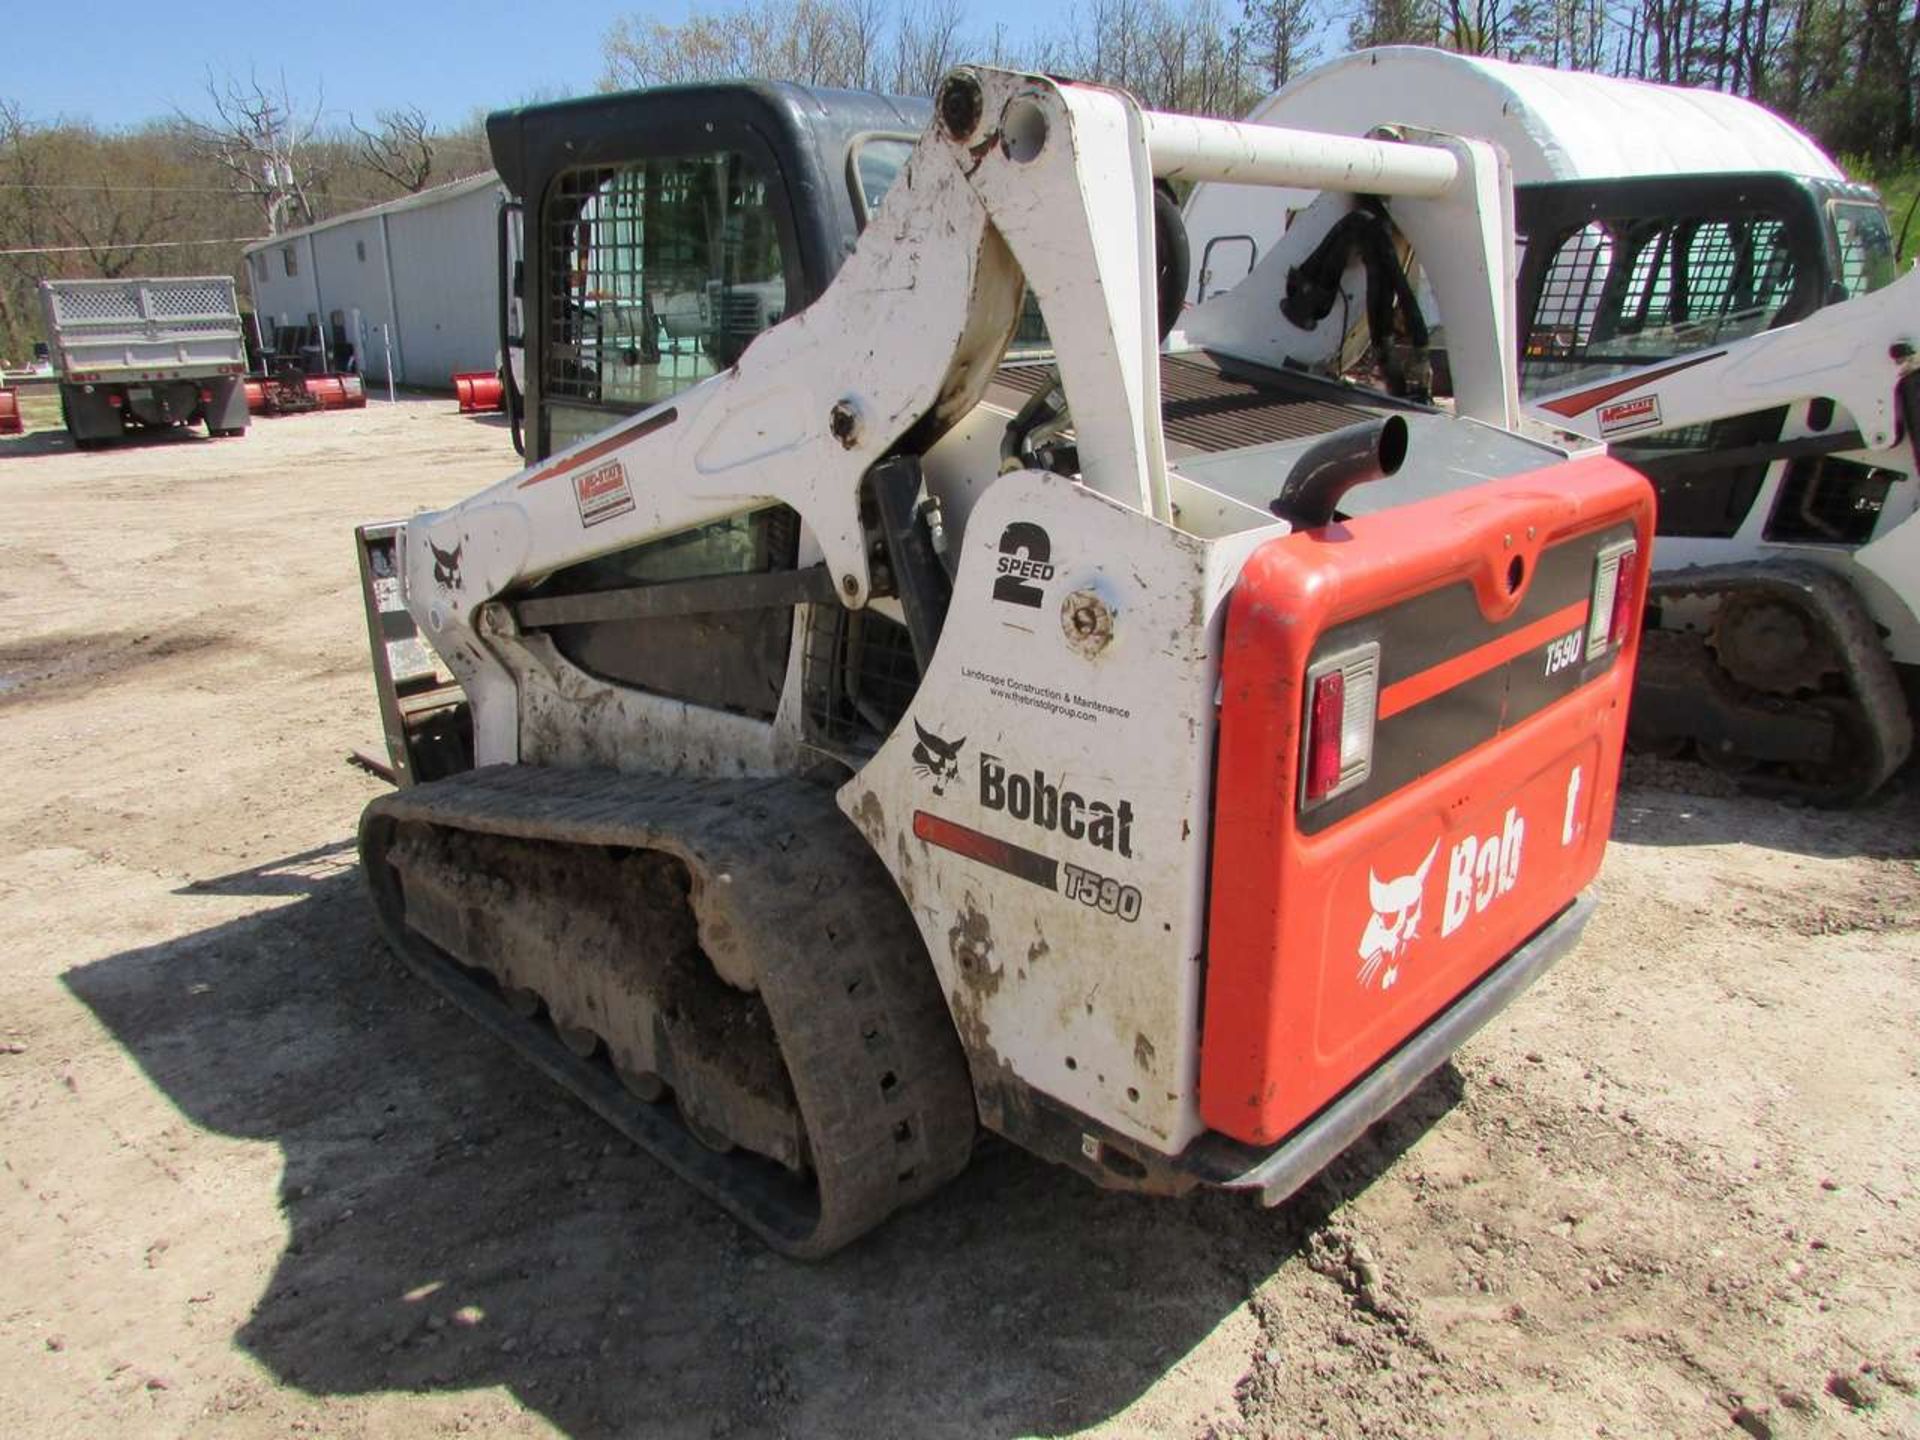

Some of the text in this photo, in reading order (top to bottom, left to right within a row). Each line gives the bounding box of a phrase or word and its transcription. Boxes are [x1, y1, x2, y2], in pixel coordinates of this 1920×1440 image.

[993, 521, 1051, 609] 2
[996, 556, 1055, 582] SPEED
[1545, 629, 1582, 677] T590
[961, 665, 1131, 719] Landscape Construction & Maintenance
[989, 686, 1098, 723] www.thebristolgroup.com
[980, 752, 1134, 859] Bobcat
[1063, 863, 1143, 923] T590
